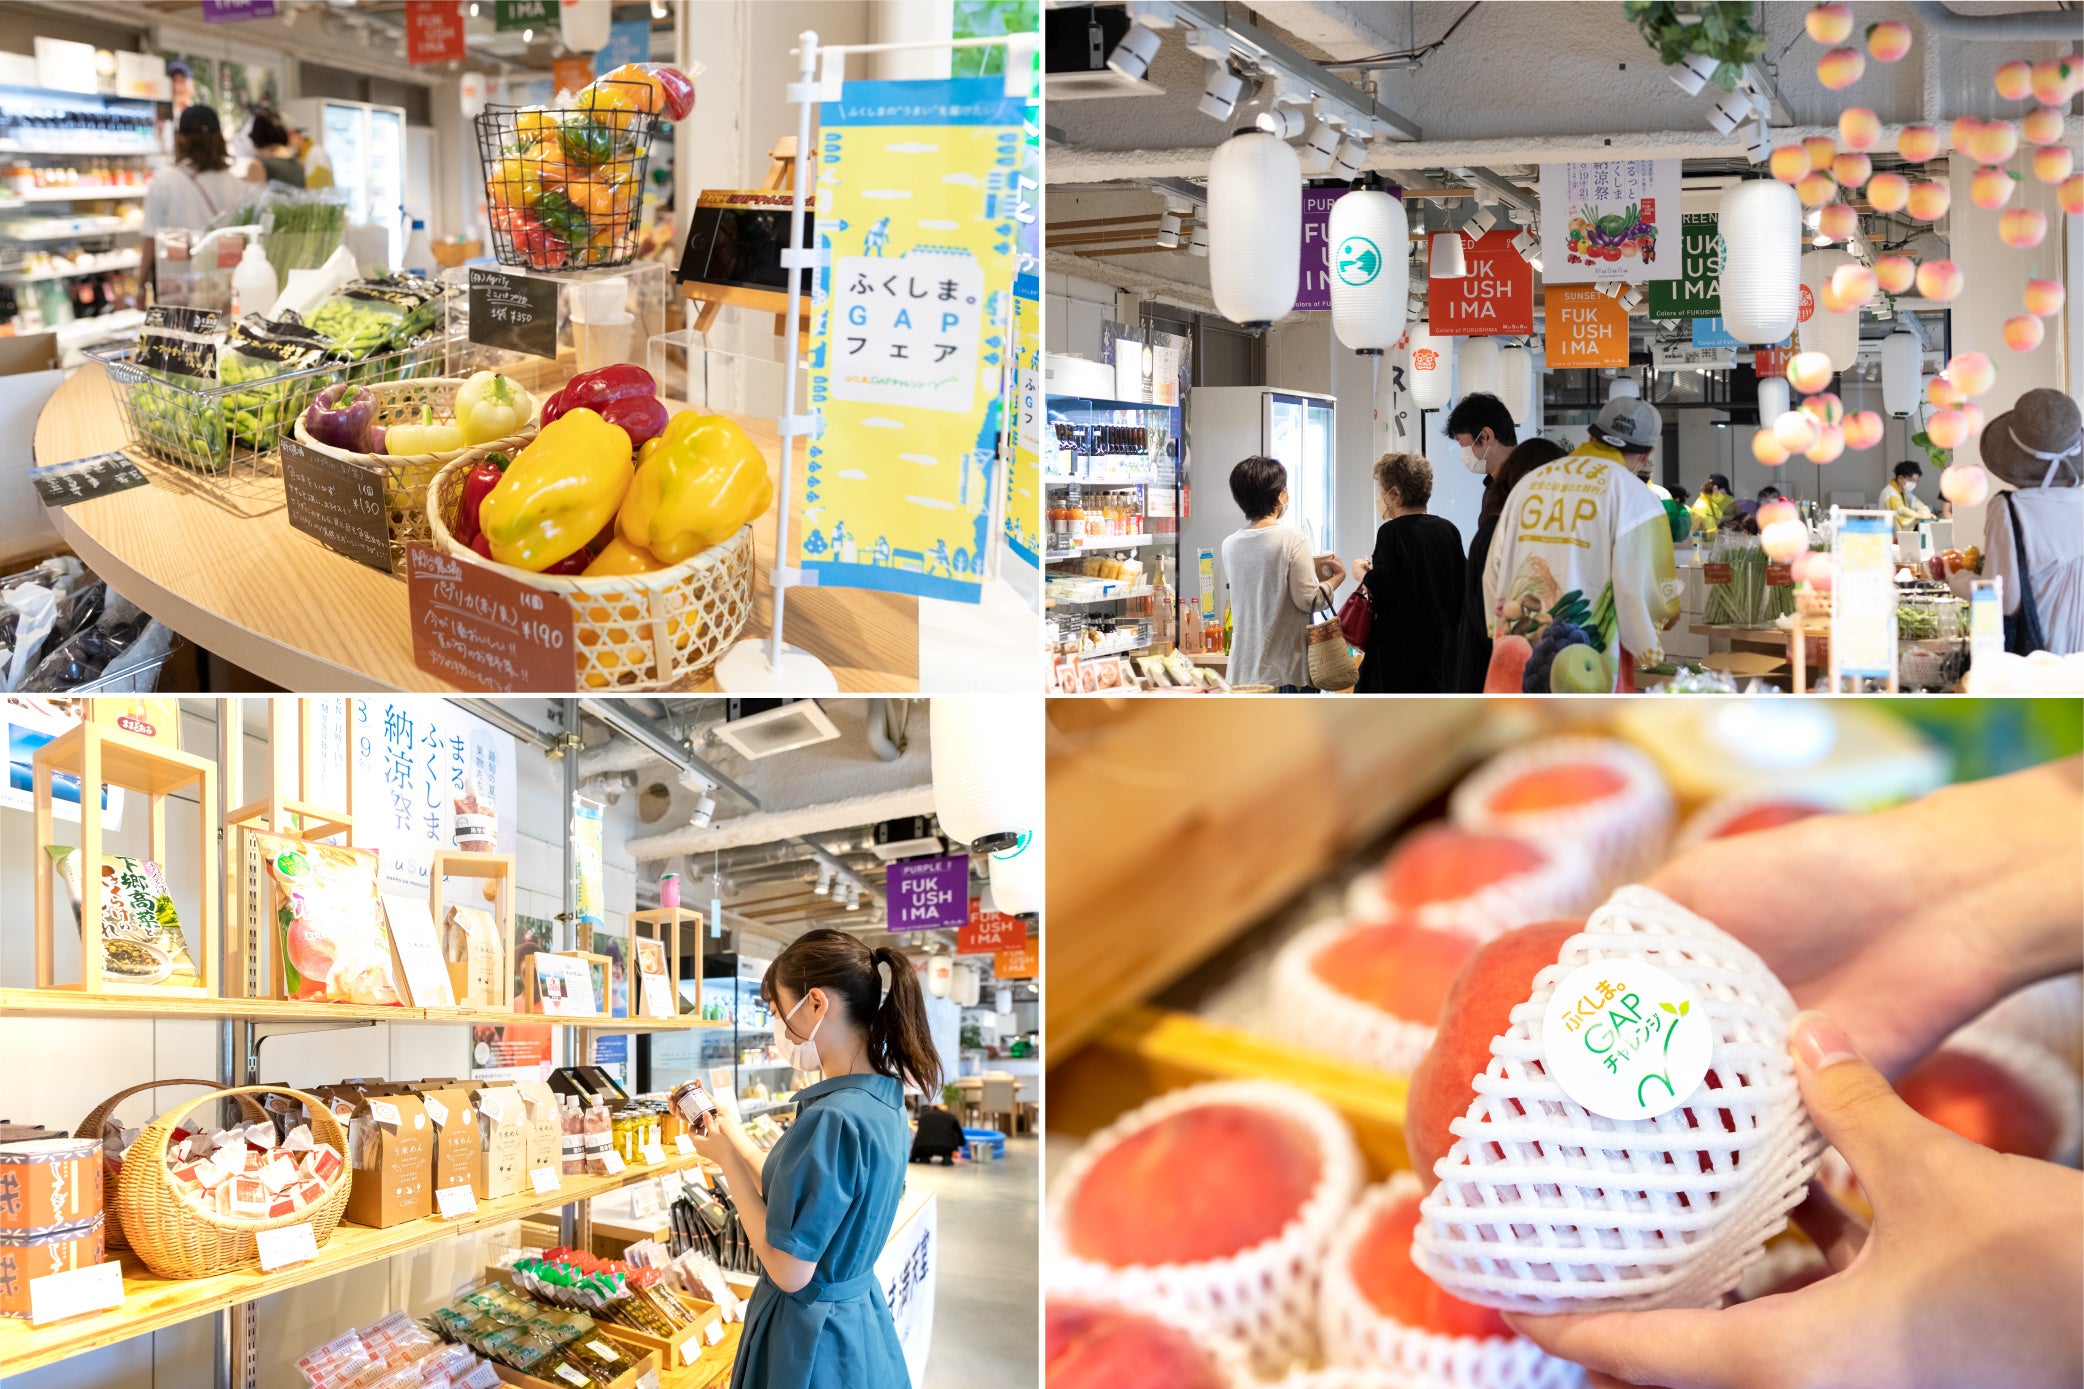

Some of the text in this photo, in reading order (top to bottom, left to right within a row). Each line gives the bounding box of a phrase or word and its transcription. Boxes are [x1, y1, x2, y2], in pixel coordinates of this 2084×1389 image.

[1682, 213, 1718, 224] REEN
[1462, 239, 1476, 250] ED
[1682, 235, 1719, 255] UK
[1466, 259, 1495, 278] UK
[849, 273, 977, 305] ふくしま。
[1463, 280, 1513, 298] USH
[1449, 301, 1497, 319] IMA
[1561, 307, 1599, 323] FUK
[1573, 324, 1612, 339] USH
[847, 336, 958, 363] フェア
[1562, 341, 1600, 355] IMA
[352, 498, 380, 516] ¥130
[1520, 494, 1598, 533] GAP
[522, 620, 564, 649] ¥190
[384, 703, 414, 831] 納涼祭
[421, 723, 444, 842] ふくしま
[903, 863, 942, 875] PURPLE
[901, 877, 939, 894] FUK
[912, 889, 953, 906] USH
[902, 906, 940, 921] IMA
[979, 921, 1014, 934] USH
[971, 934, 1002, 945] IMA
[1561, 979, 1626, 1033] ふくしま。
[1584, 993, 1643, 1054] GAP
[1603, 1013, 1662, 1074] チャレンジ
[394, 1144, 424, 1156] う米めん
[448, 1137, 472, 1146] う米めん
